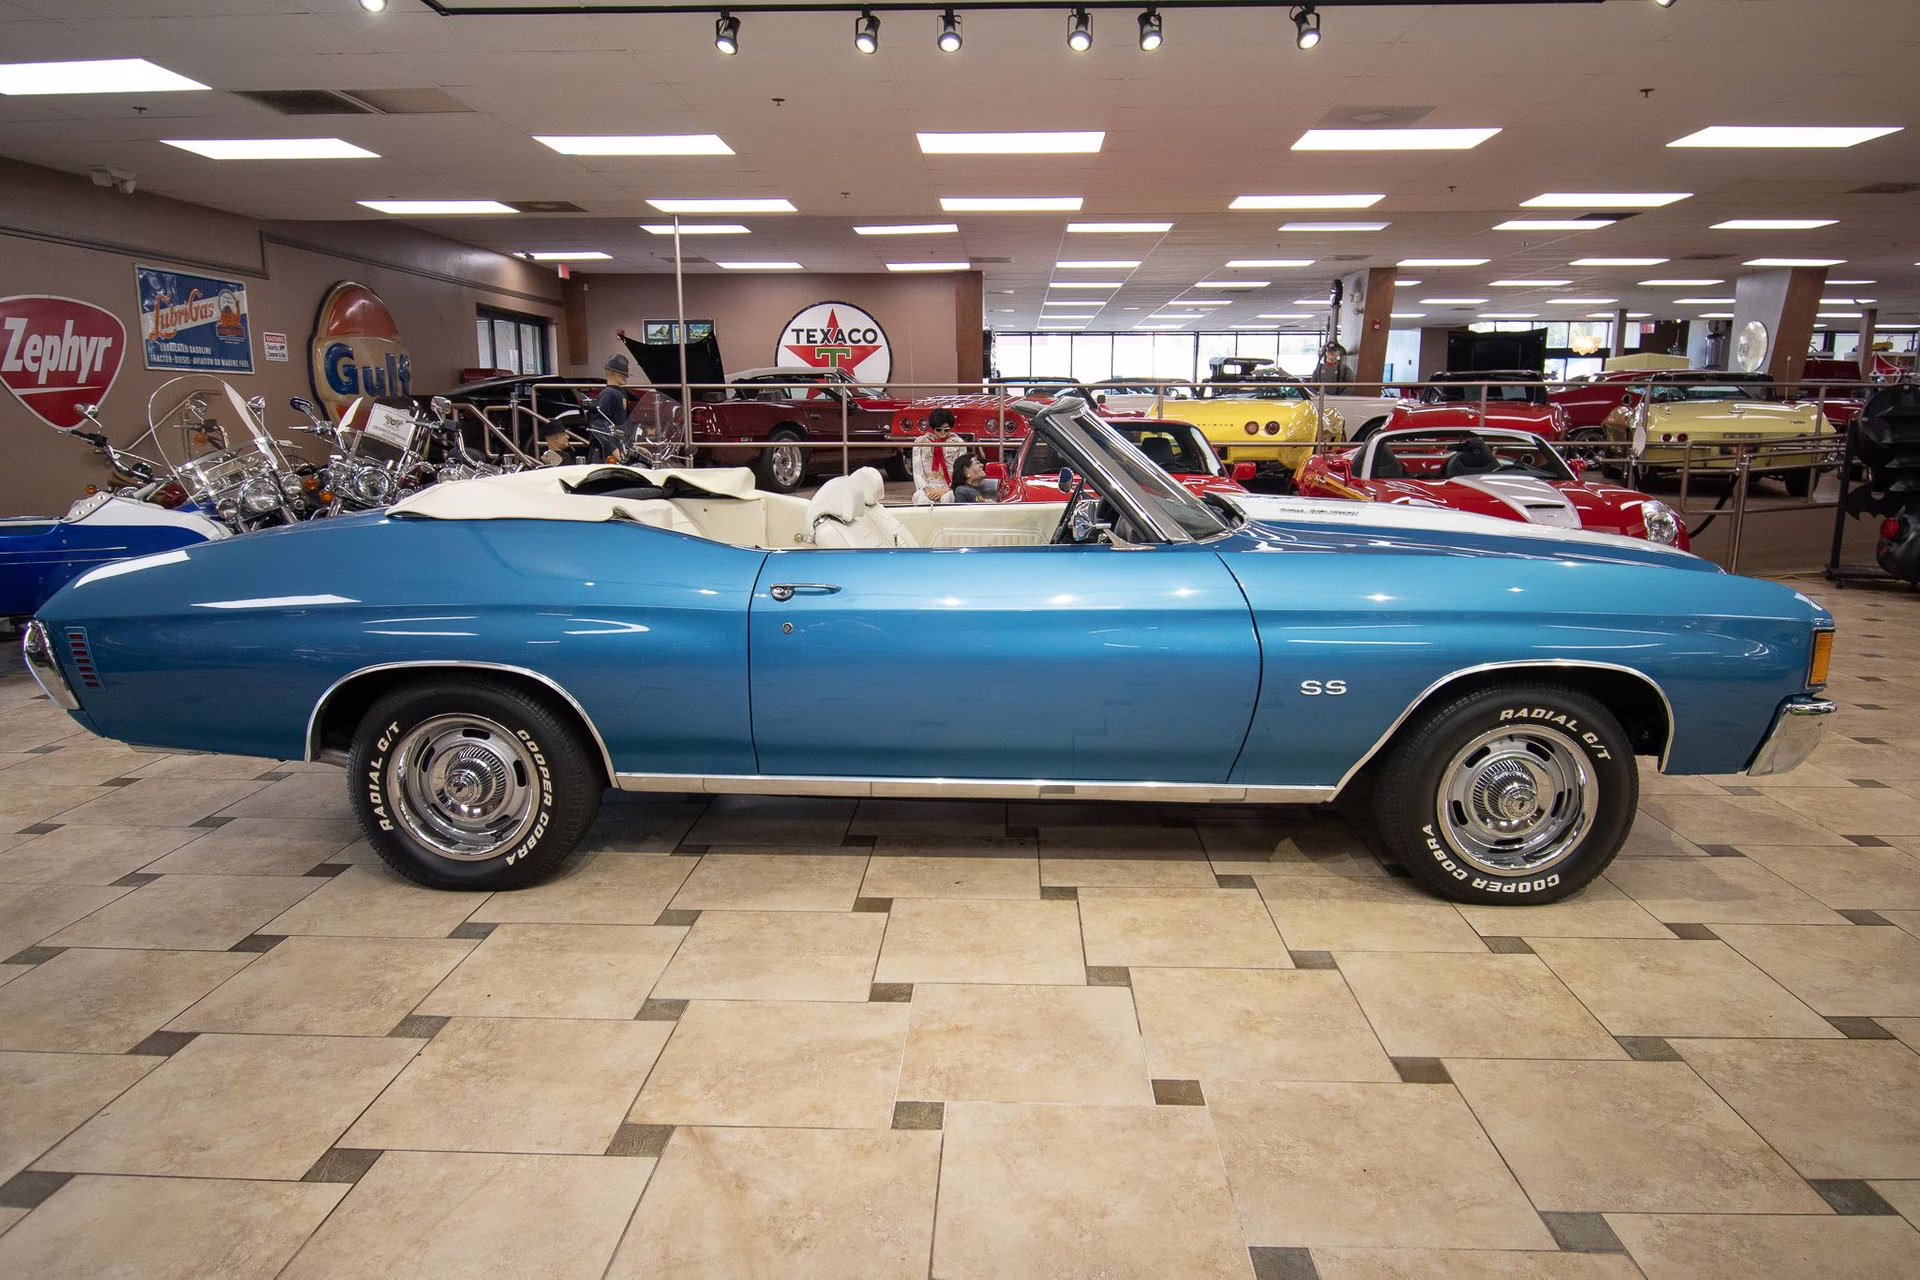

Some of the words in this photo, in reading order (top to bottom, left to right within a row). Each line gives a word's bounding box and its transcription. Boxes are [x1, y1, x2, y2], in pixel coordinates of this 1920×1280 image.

[1, 317, 113, 385] Zephyr
[160, 343, 189, 353] LUBRICATED
[189, 346, 212, 355] GASOLINE
[791, 328, 878, 345] TEXACO
[325, 343, 411, 399] Gulf
[1300, 680, 1347, 695] SS
[377, 721, 401, 752] G/T
[1500, 707, 1578, 732] RADIAL
[1582, 731, 1612, 761] G/T
[369, 757, 394, 832] RADIAL
[516, 729, 552, 807] COOPER
[505, 814, 549, 866] COBRA
[1422, 823, 1468, 881] COBRA
[1472, 873, 1560, 893] COOPER
